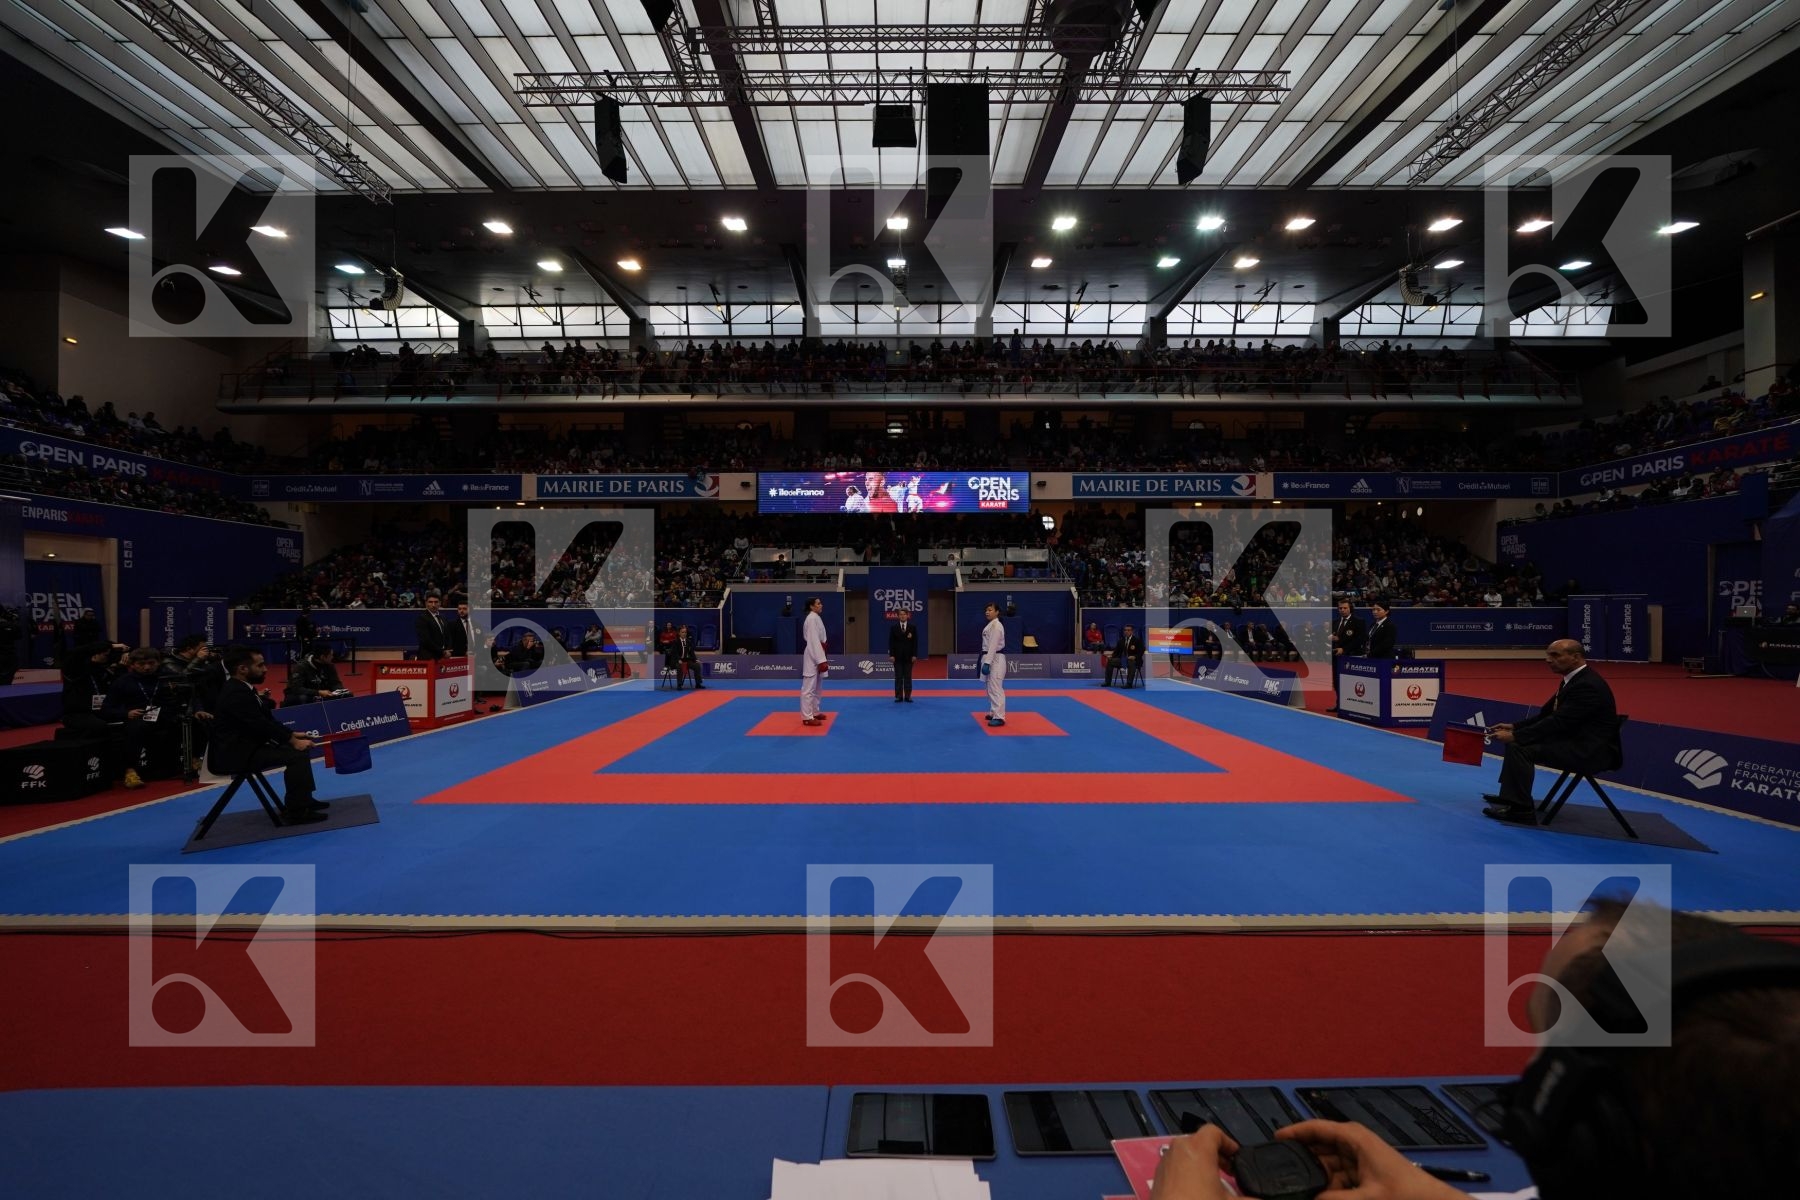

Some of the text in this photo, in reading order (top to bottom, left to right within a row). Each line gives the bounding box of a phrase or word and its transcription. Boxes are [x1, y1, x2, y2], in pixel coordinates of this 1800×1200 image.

[19, 441, 84, 466] OPEN
[92, 454, 148, 477] PARIS
[1580, 467, 1625, 487] OPEN
[1632, 456, 1685, 478] PARIS
[544, 480, 685, 493] MAIRIE DE PARIS
[968, 476, 1011, 489] OPEN
[1079, 479, 1222, 492] MAIRIE DE PARIS
[979, 488, 1020, 501] PARIS
[1719, 580, 1763, 596] OPE
[874, 589, 915, 601] OPEN
[884, 600, 924, 612] PARIS
[714, 662, 733, 670] RMC
[1263, 679, 1280, 689] RMC
[340, 712, 399, 732] Crédit Mutuel
[1736, 760, 1800, 779] FÉDÉRATIO
[20, 780, 47, 789] FFK
